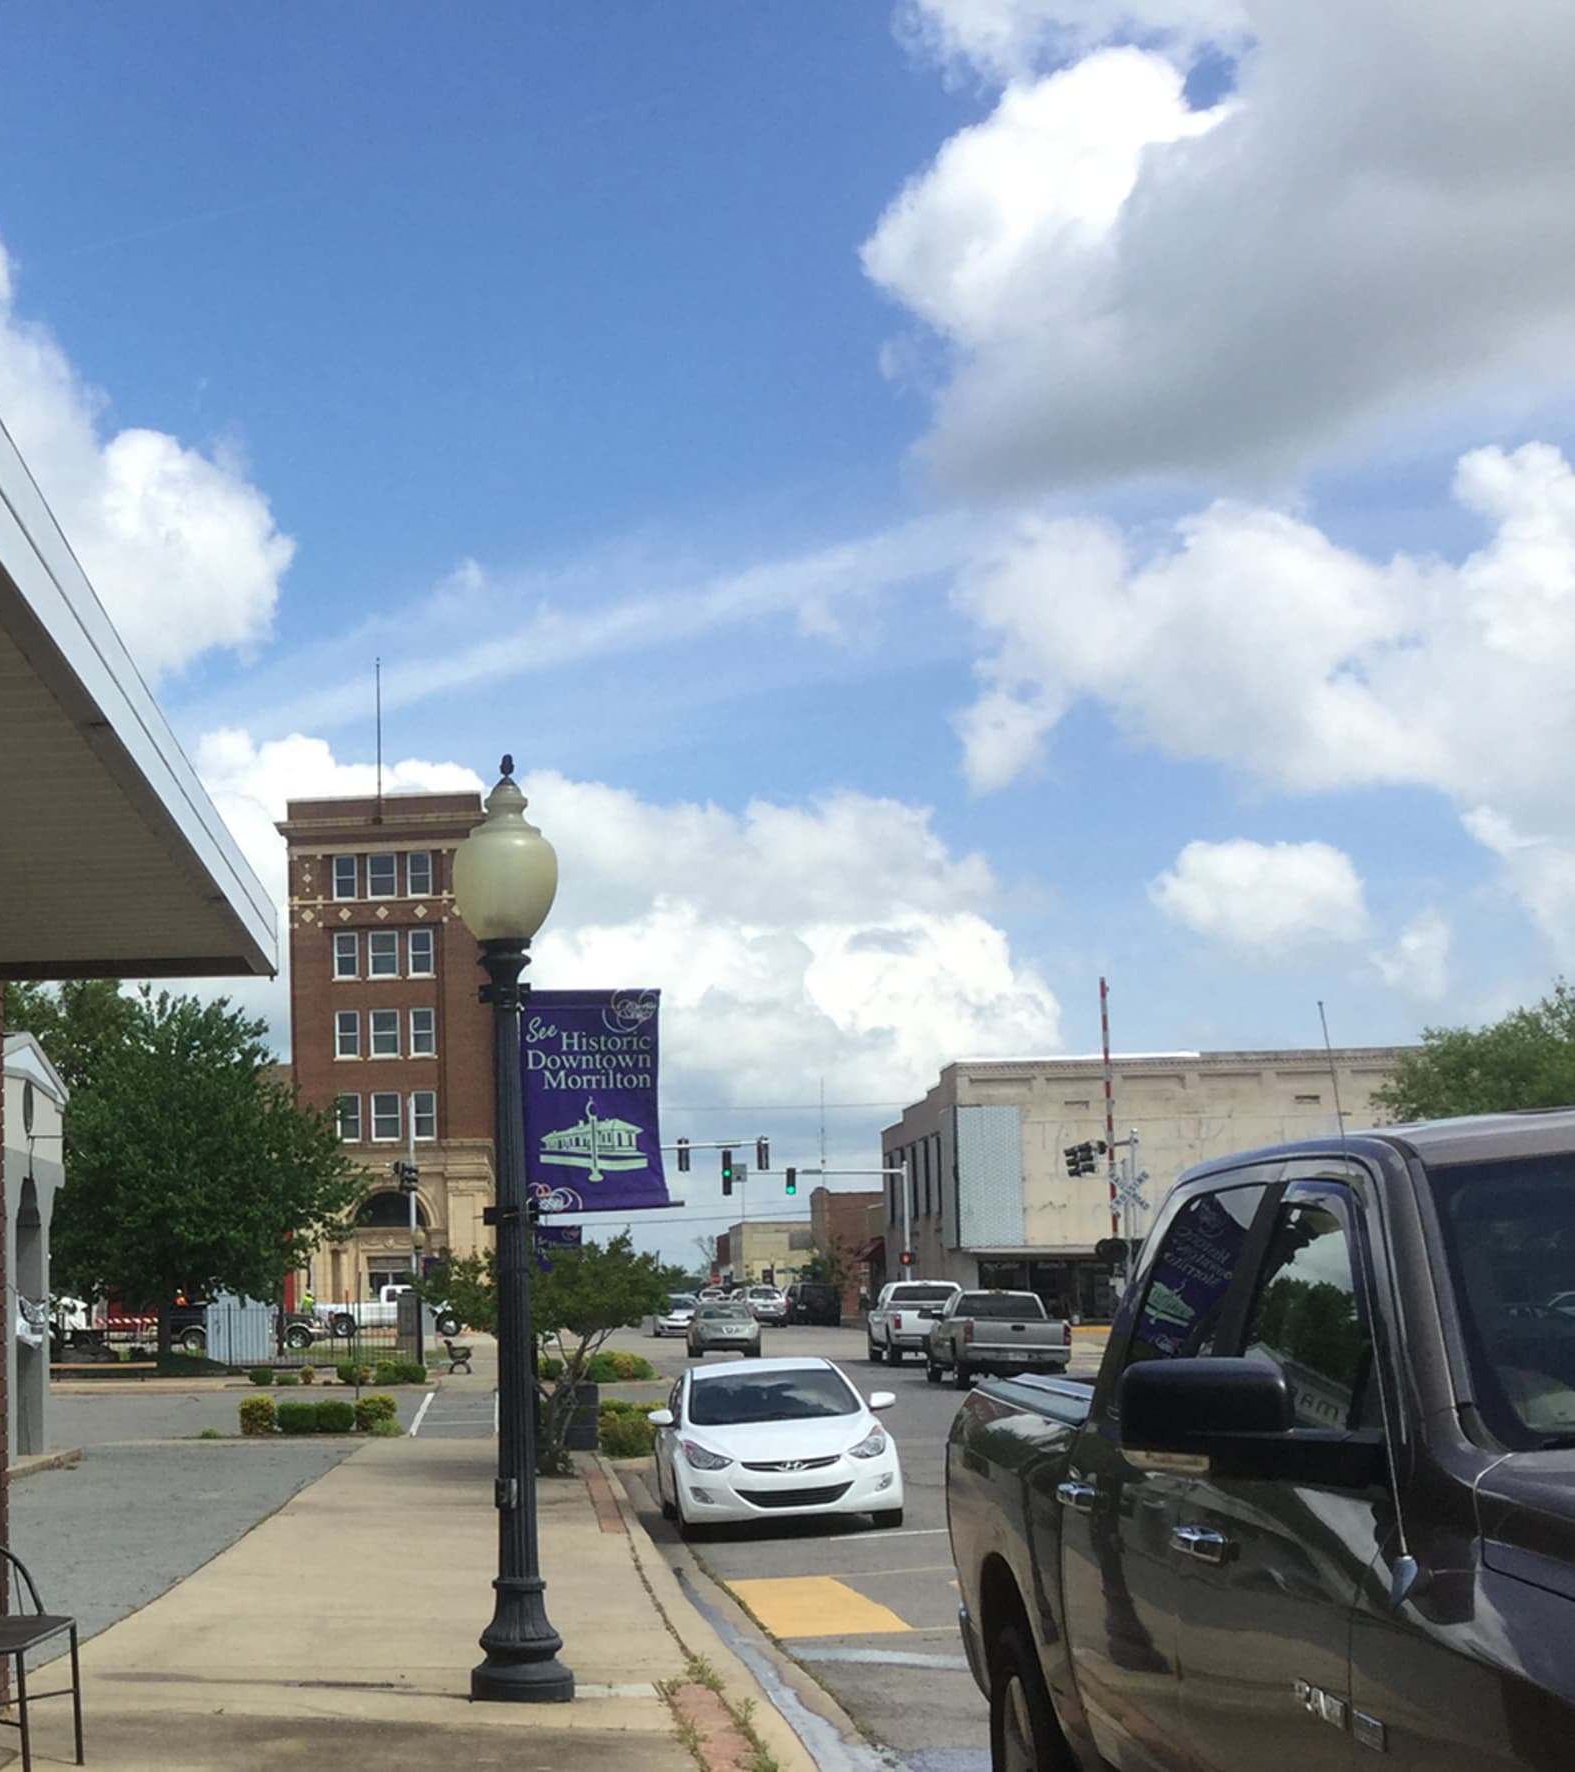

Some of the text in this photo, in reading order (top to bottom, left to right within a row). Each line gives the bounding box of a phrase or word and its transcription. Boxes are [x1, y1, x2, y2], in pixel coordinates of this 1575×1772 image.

[526, 1016, 558, 1044] See
[561, 1031, 651, 1052] Historic
[527, 1050, 651, 1070] Downtown
[542, 1070, 651, 1090] Morrilton
